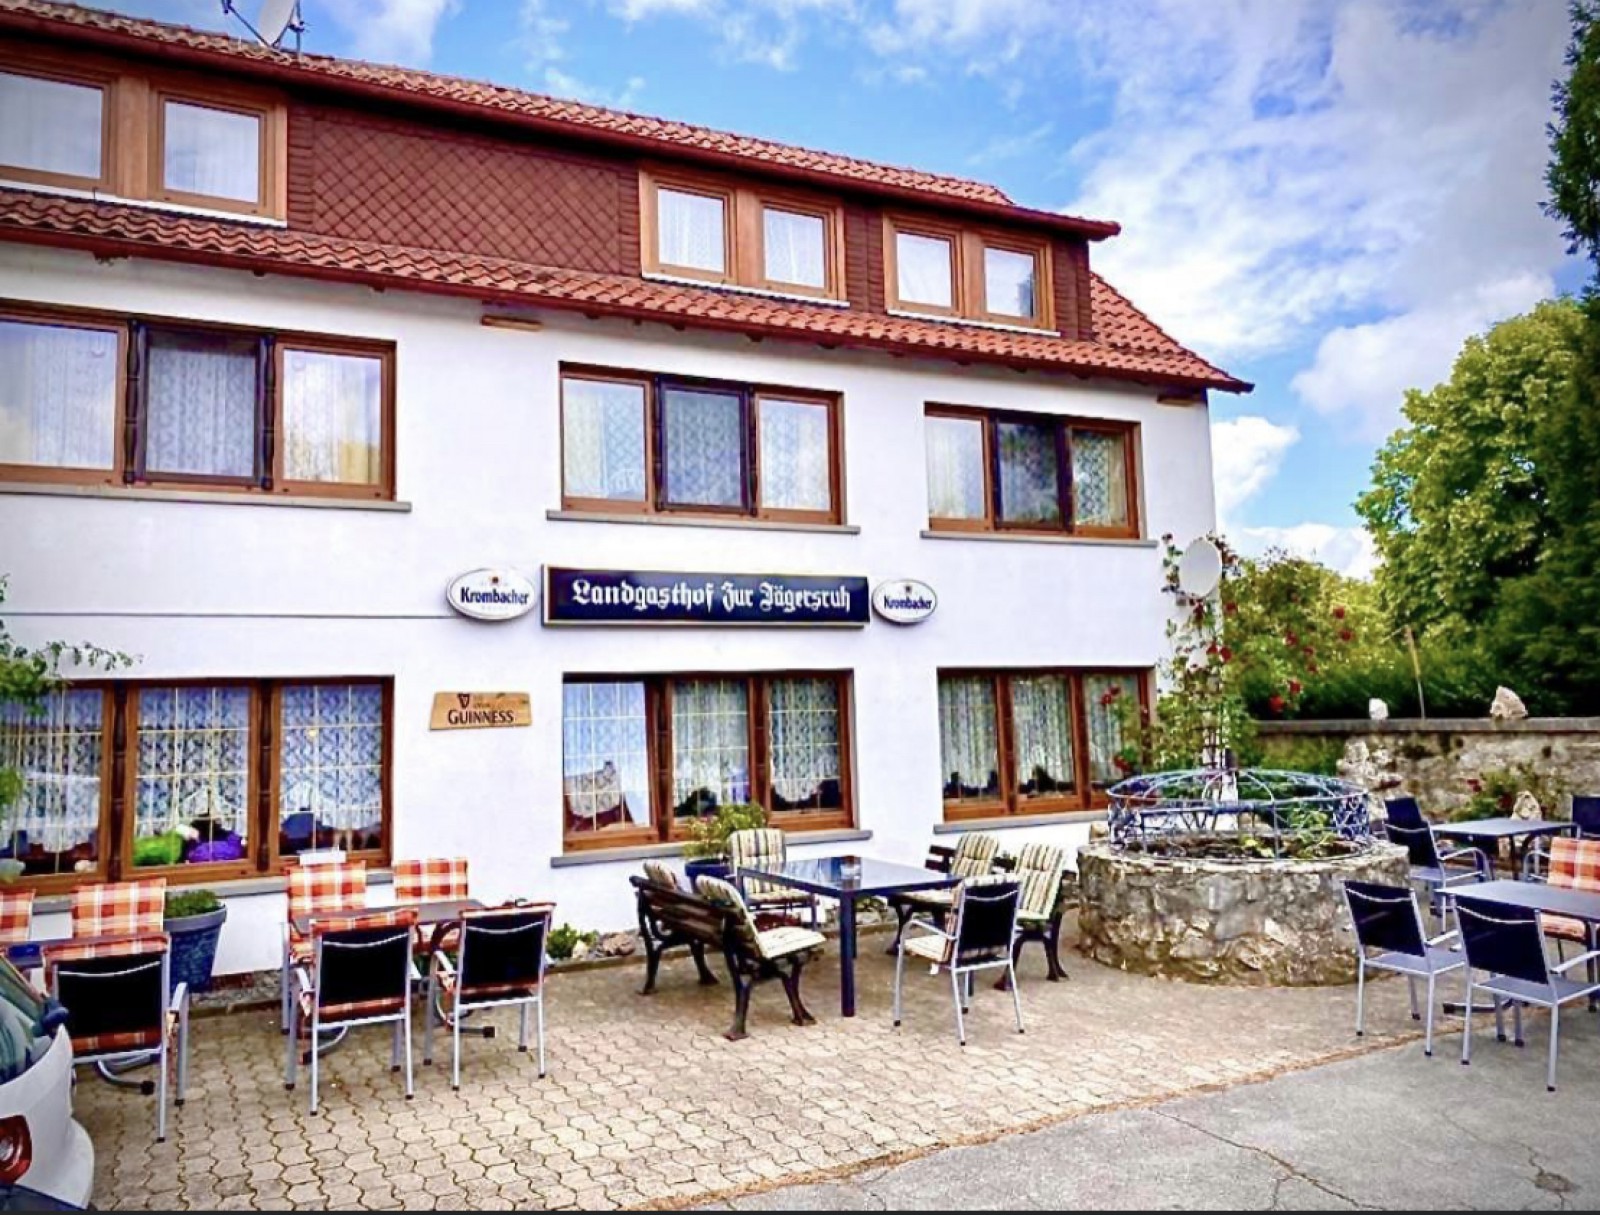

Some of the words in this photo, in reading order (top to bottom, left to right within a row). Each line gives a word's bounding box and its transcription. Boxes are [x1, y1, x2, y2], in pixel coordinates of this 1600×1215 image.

[460, 587, 530, 605] Krombacher
[572, 578, 714, 614] Landgasthof
[759, 581, 851, 614] Jägersruh
[883, 594, 933, 610] Krombacher
